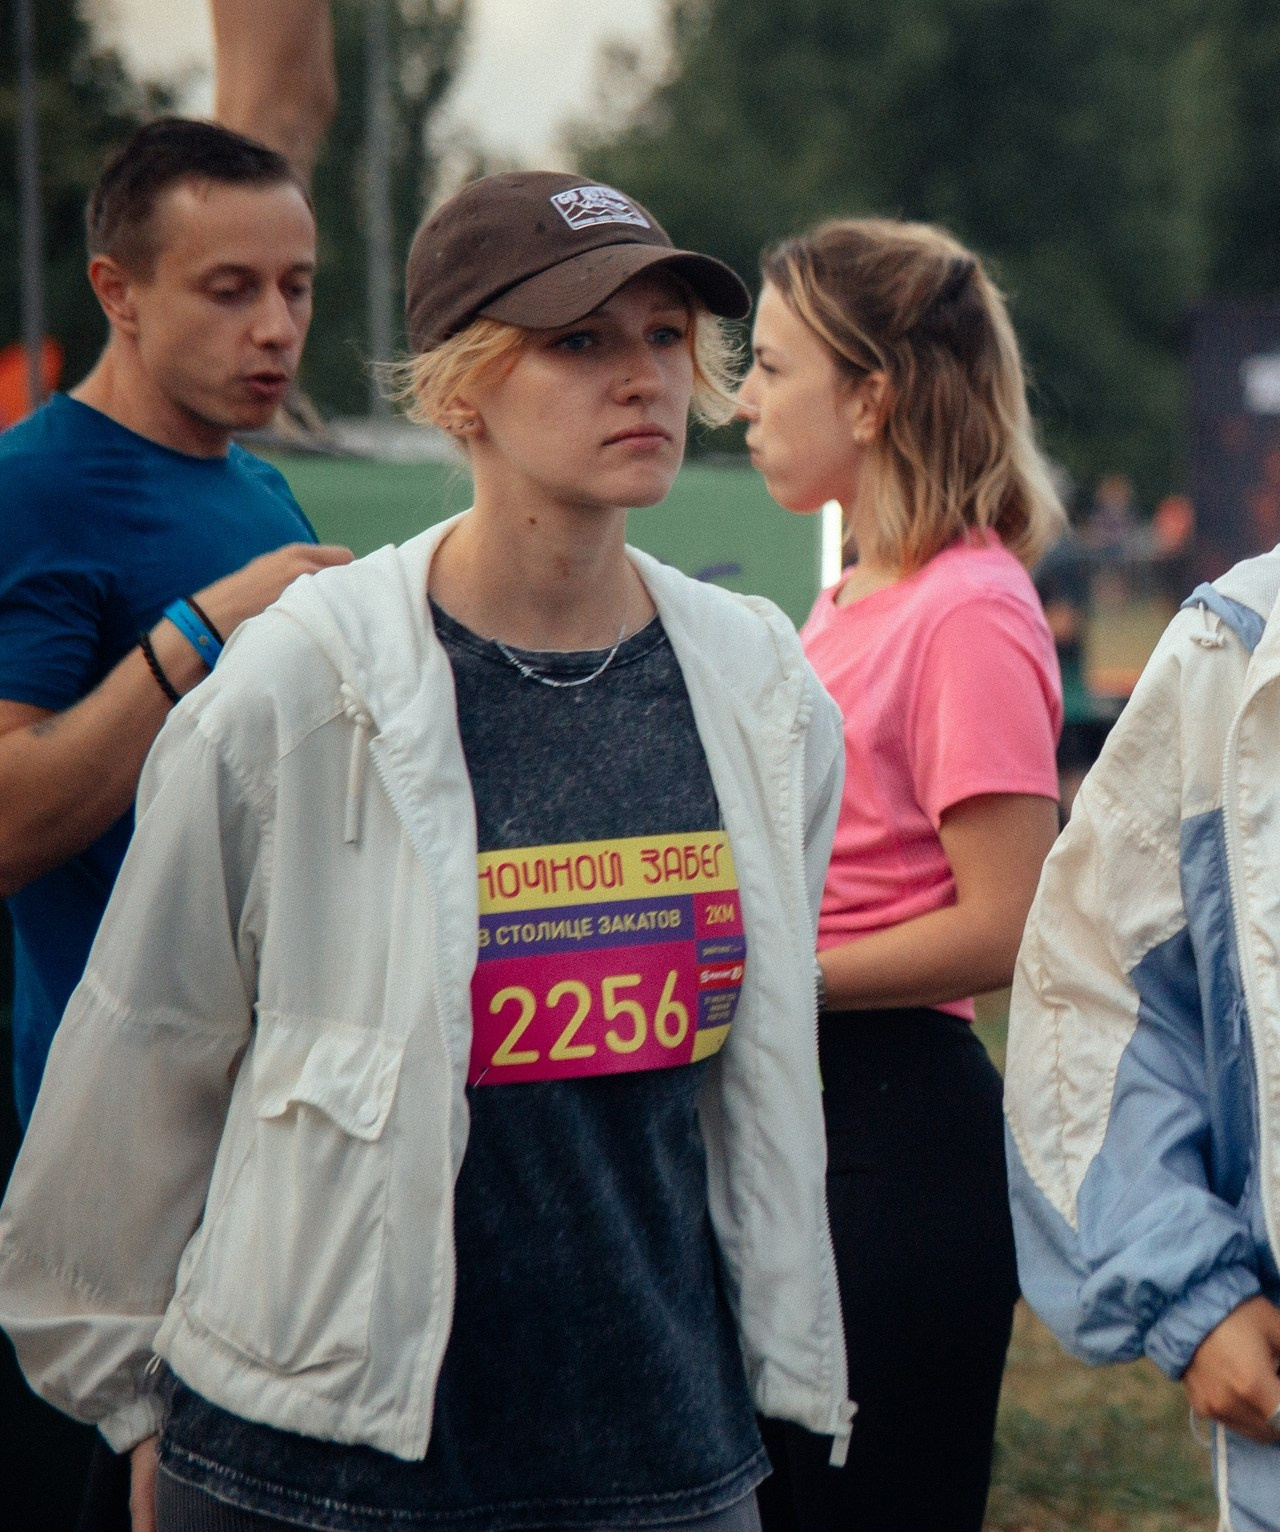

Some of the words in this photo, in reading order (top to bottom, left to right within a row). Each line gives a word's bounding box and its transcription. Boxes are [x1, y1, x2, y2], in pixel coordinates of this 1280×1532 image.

[640, 843, 725, 885] ЗАБЕГ
[495, 917, 594, 947] СТОЛИЦЕ
[597, 908, 681, 935] ЗАКАТОВ
[705, 903, 736, 926] 2КМ
[488, 969, 689, 1067] 2256
